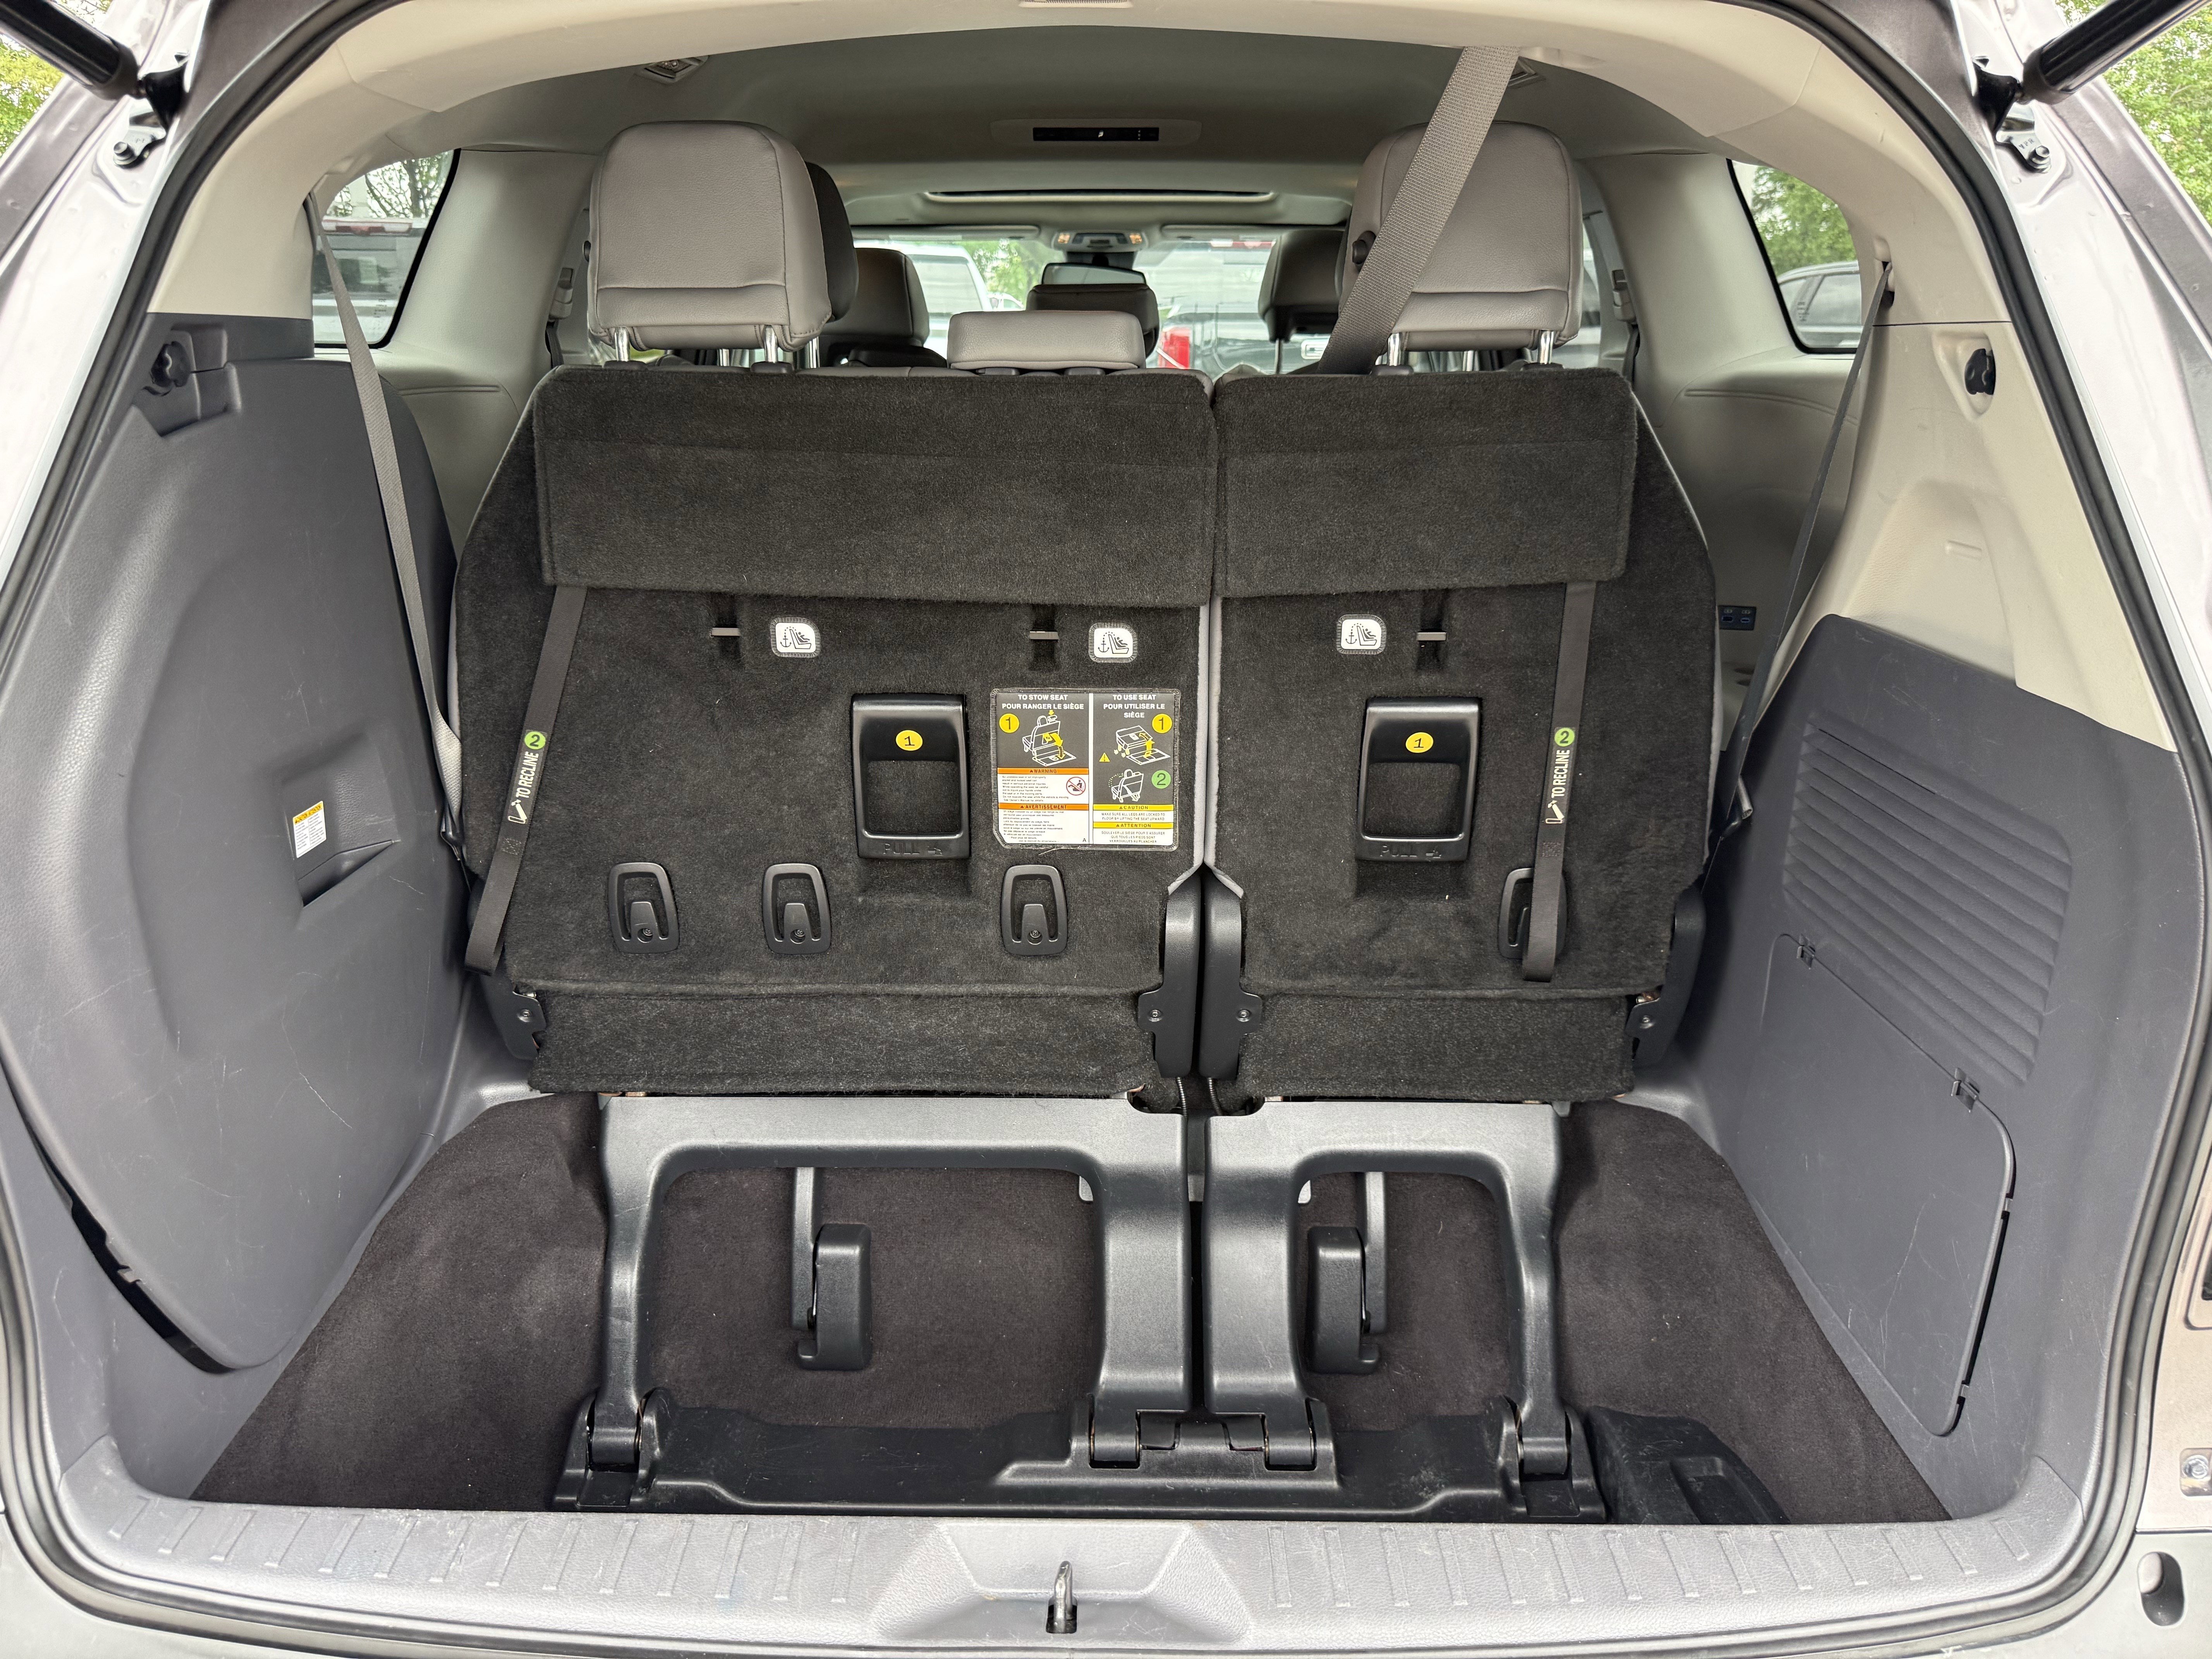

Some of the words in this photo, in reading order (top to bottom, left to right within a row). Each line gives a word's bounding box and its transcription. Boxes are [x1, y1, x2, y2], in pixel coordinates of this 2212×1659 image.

[1005, 716, 1011, 730] 1
[1158, 717, 1164, 730] 1
[529, 734, 540, 747] 2
[904, 736, 915, 746] 1
[1413, 738, 1424, 748] 1
[1559, 731, 1569, 744] 2
[518, 751, 539, 788] RECLINE
[1553, 750, 1570, 785] RECLINE
[1157, 773, 1166, 785] 2
[516, 787, 531, 798] TO
[1551, 787, 1566, 798] TO
